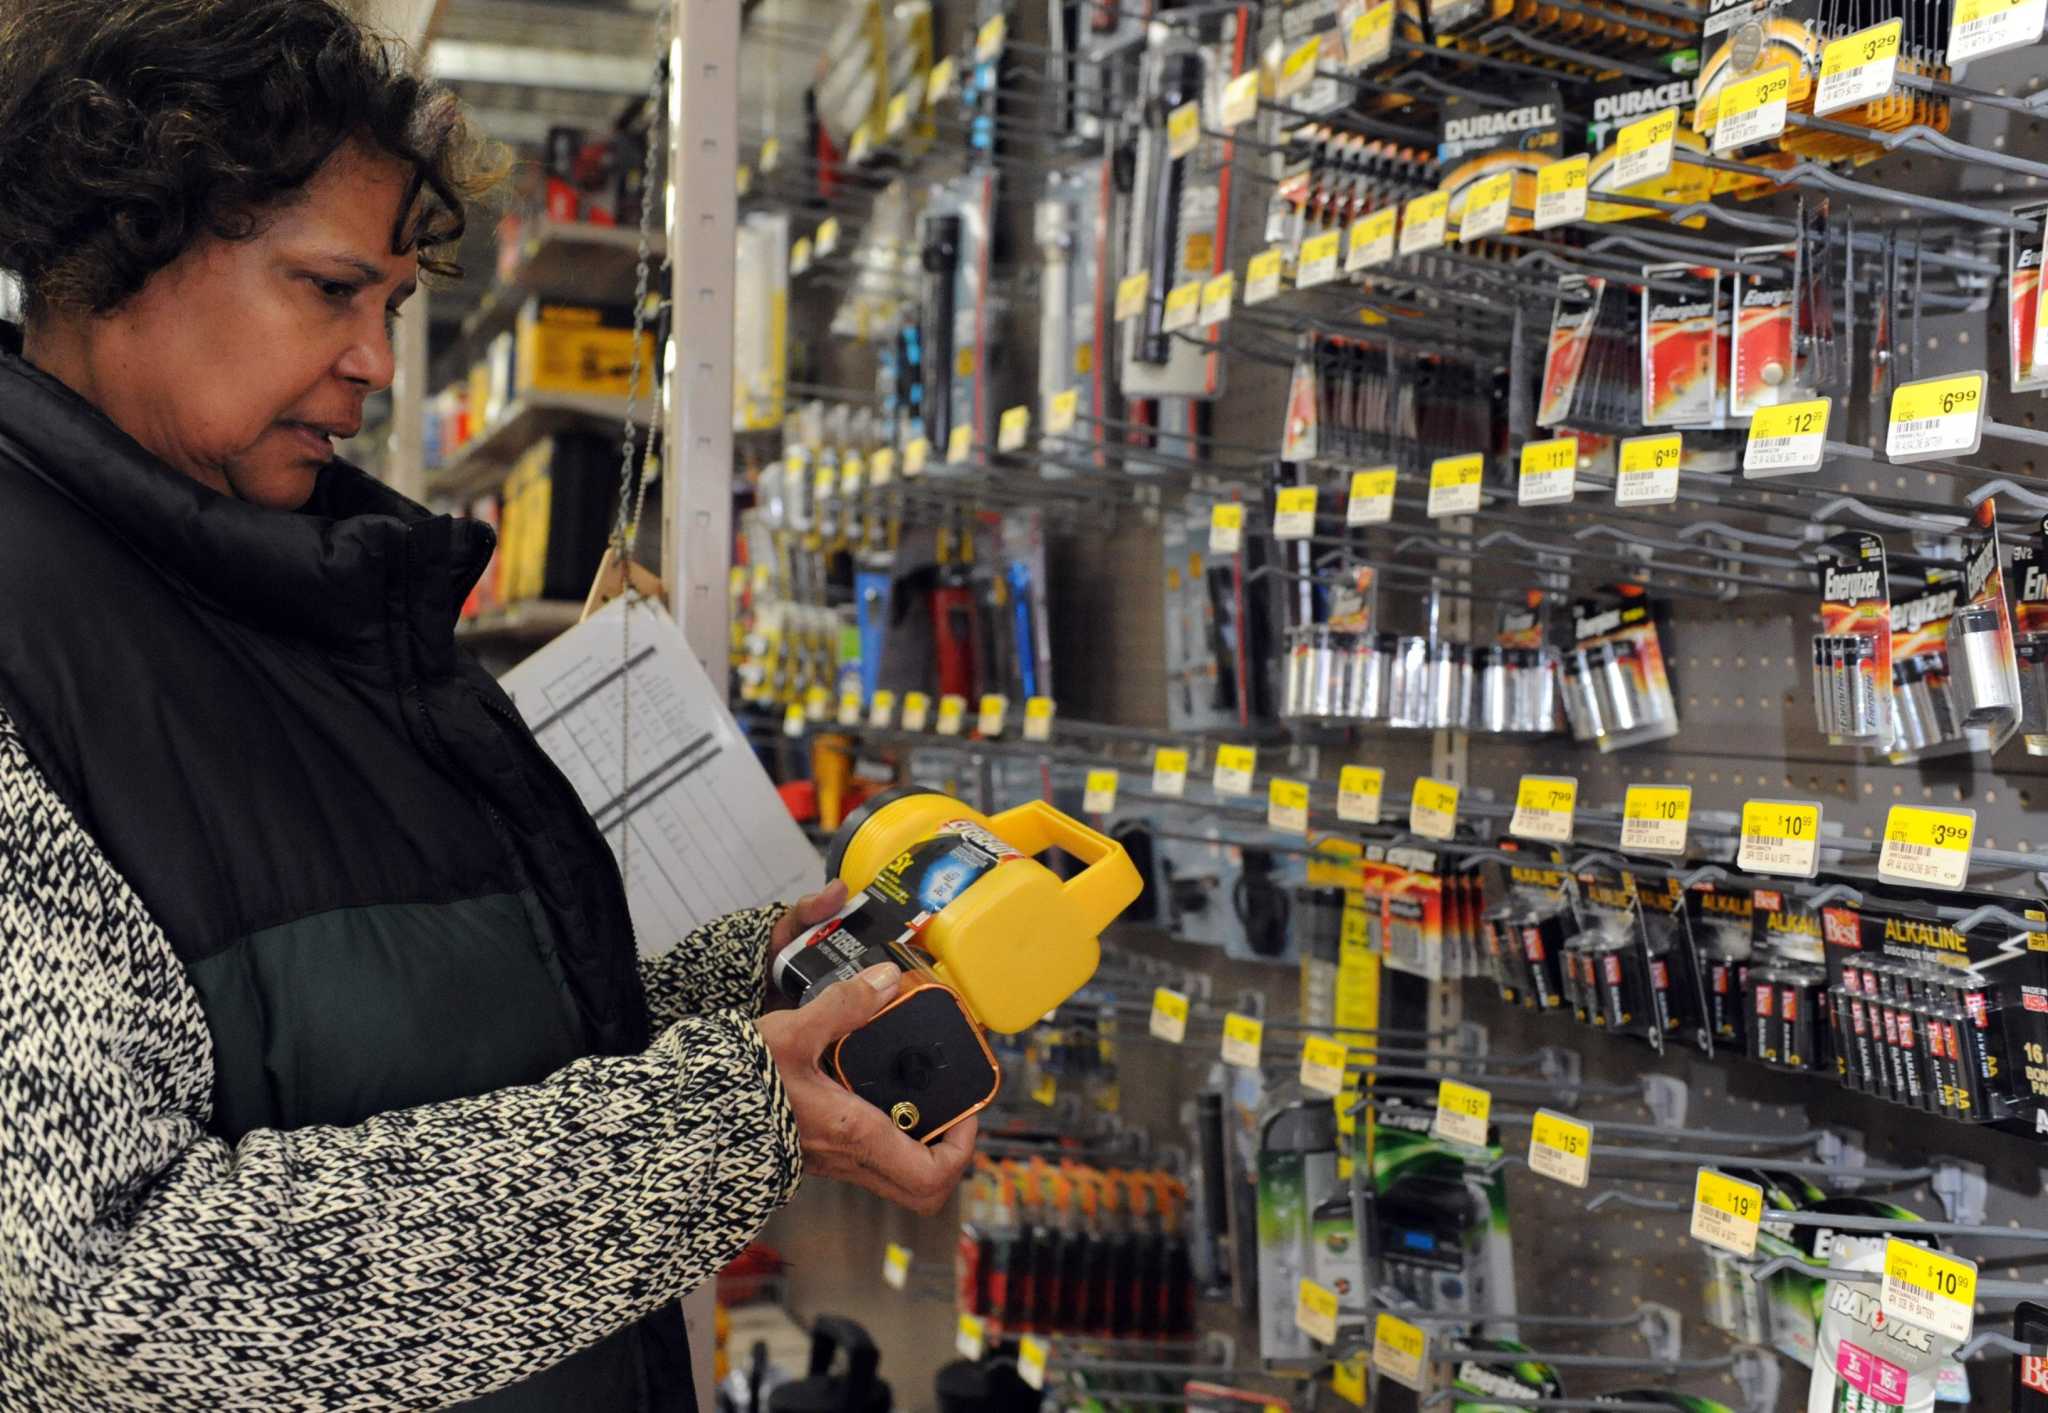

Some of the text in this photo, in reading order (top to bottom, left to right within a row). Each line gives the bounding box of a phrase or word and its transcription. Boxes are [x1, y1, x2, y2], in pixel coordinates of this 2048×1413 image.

[1445, 103, 1556, 141] DURACELL
[1825, 566, 1881, 608] Energizer
[1824, 912, 1859, 946] Best
[1885, 918, 1968, 952] ALKALINE
[2024, 1042, 2044, 1064] 16
[1829, 1281, 1935, 1354] RAYOVAC
